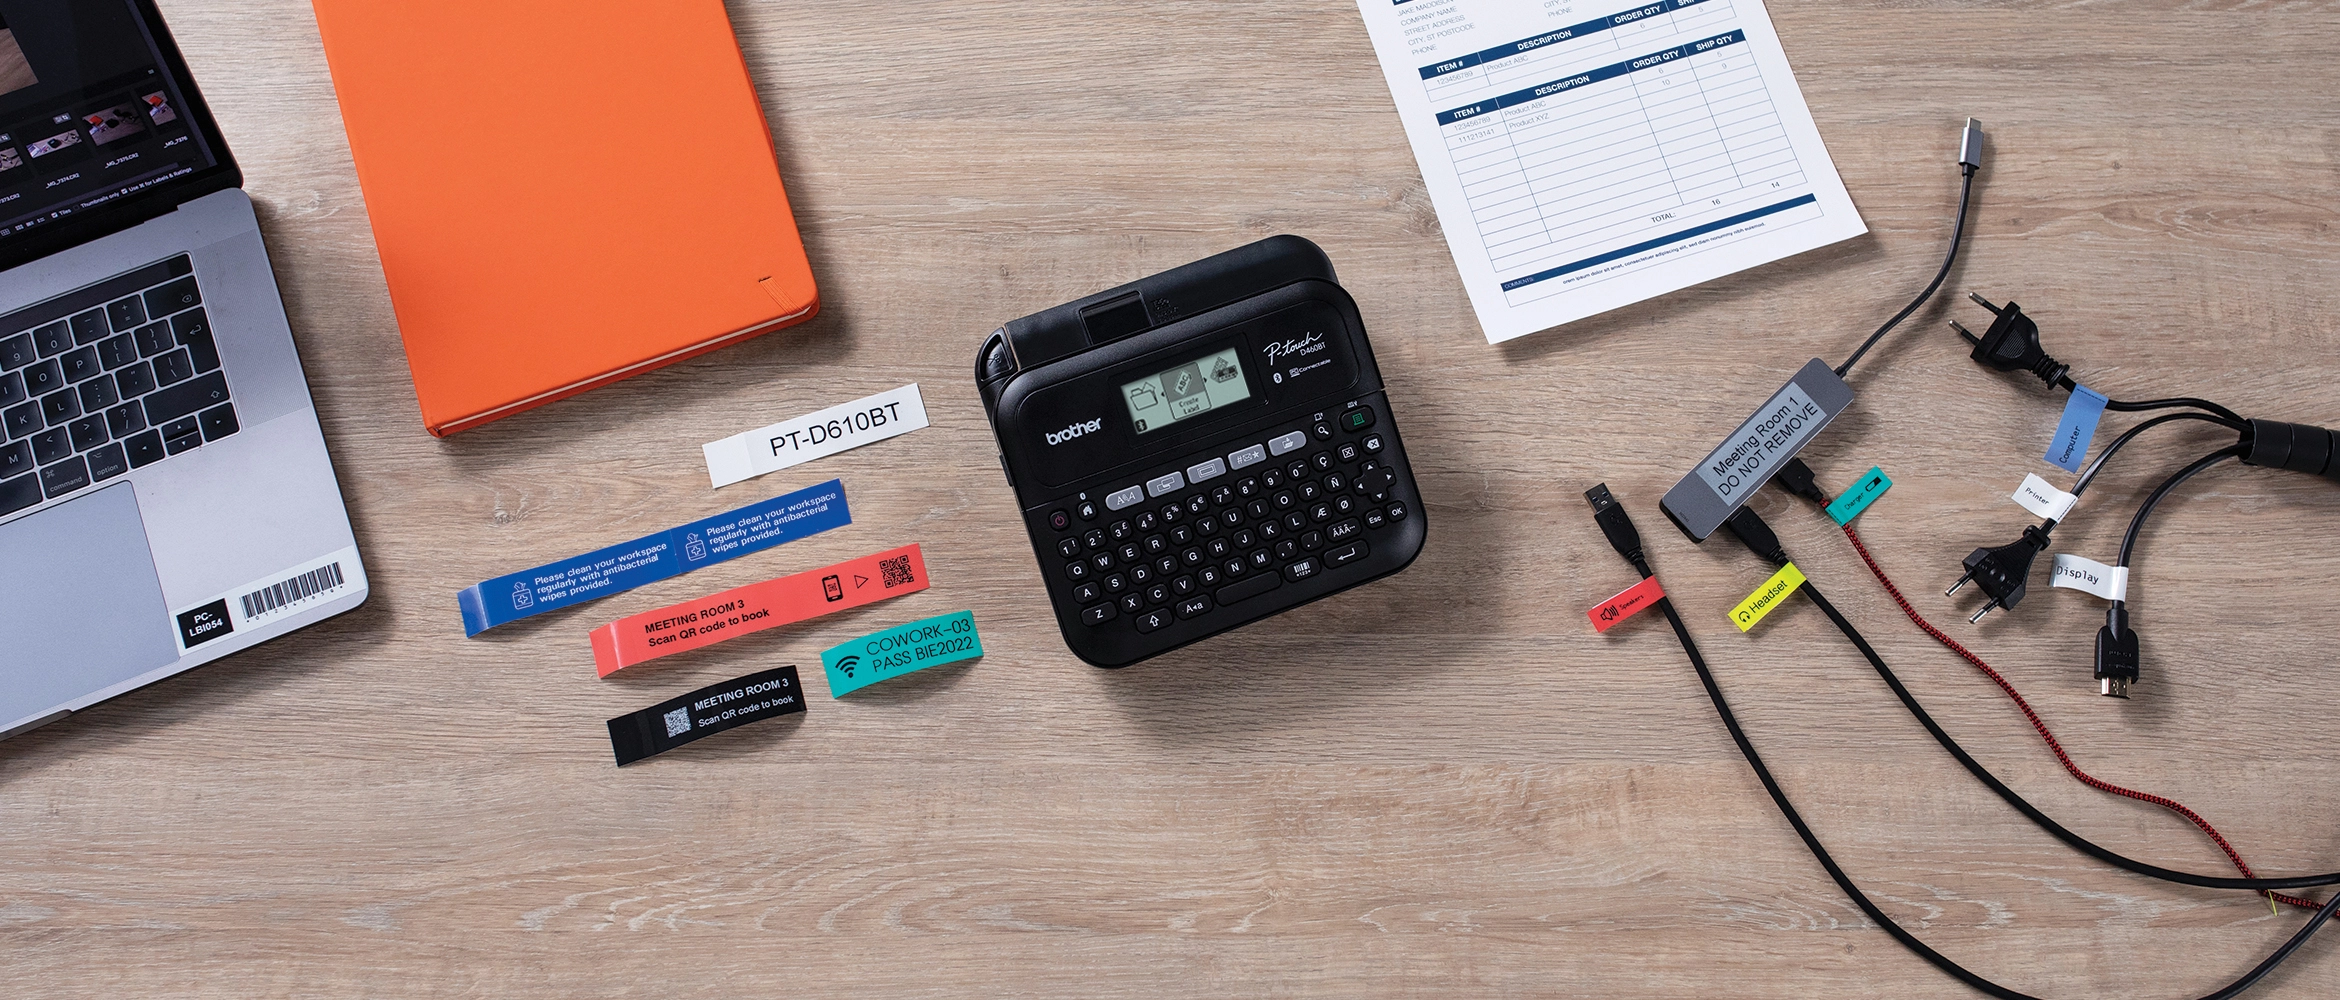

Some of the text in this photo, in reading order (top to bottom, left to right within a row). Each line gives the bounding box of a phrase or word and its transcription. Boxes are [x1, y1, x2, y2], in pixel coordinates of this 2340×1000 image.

[1398, 7, 1415, 17] JAKE
[1400, 6, 1458, 26] COMPANY NAME
[1548, 6, 1573, 18] PHONE
[1614, 5, 1661, 24] ORDER QTY
[1404, 15, 1465, 36] STREET ADDRESS
[1408, 37, 1426, 46] CITY,
[1438, 23, 1475, 38] POSTCODE
[1412, 44, 1438, 55] PHONE
[1517, 30, 1572, 51] DESCRIPTION
[1696, 35, 1733, 51] SHIP QTY
[1436, 62, 1457, 74] ITEM
[1486, 55, 1529, 71] Product ABC
[1633, 50, 1679, 69] ORDER QTY
[1436, 70, 1474, 86] 123456789
[1535, 75, 1590, 96] DESCRIPTION
[1662, 78, 1671, 86] 10
[1454, 107, 1475, 119] ITEM
[1504, 100, 1547, 117] Product ABC
[1454, 116, 1491, 131] 123456789
[1509, 113, 1550, 129] Product XYZ
[1458, 128, 1495, 143] 111213141
[152, 175, 169, 184] Labels
[174, 167, 192, 177] Ratings
[80, 192, 120, 209] Thumbnails only
[59, 208, 72, 216] Tiles
[1651, 212, 1676, 224] TOTAL:
[1263, 331, 1323, 366] P-touch
[1300, 342, 1326, 356] D460BT
[1177, 375, 1189, 392] ABC
[1179, 397, 1199, 408] Create
[1183, 405, 1200, 414] Label
[769, 401, 900, 457] PT-D610BT
[1045, 417, 1101, 445] brother
[1712, 396, 1799, 477] Meeting Room 1
[1718, 402, 1818, 496] DO NOT REMOVE
[2058, 425, 2081, 465] Computer
[97, 464, 119, 476] option
[50, 476, 83, 492] command
[1844, 492, 1864, 510] Charger
[2025, 487, 2050, 506] Printer
[706, 491, 837, 536] Please clean your workspace
[1368, 515, 1382, 524] Esc
[1391, 508, 1403, 516] OK
[709, 503, 828, 545] regularly with antibacterial
[712, 527, 783, 554] wipes provided.
[534, 542, 668, 586] Please clean your workspace
[536, 553, 659, 595] regularly with antibacterial
[2055, 566, 2100, 585] Display
[539, 577, 613, 603] wipes provided.
[1748, 578, 1789, 614] Headset
[1619, 594, 1644, 610] Speakers
[193, 612, 213, 624] PC-
[644, 599, 745, 635] MEETING ROOM 3
[648, 607, 770, 649] Scan QR code to book
[872, 636, 974, 673] PASS BIE2022
[694, 678, 789, 712] MEETING ROOM 3
[698, 694, 794, 728] Scan QR code to book
